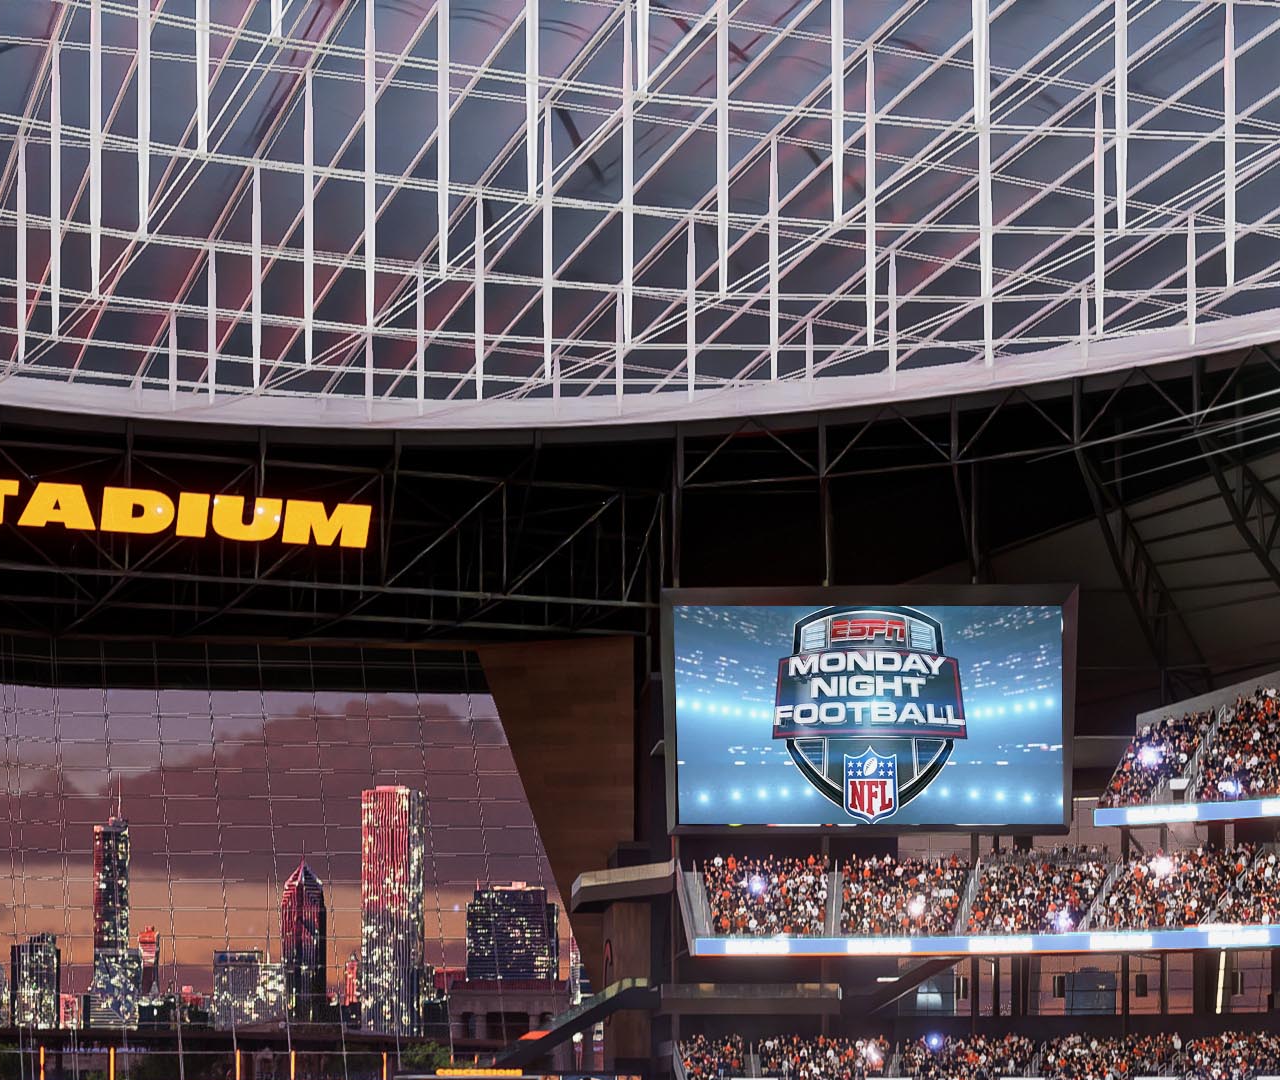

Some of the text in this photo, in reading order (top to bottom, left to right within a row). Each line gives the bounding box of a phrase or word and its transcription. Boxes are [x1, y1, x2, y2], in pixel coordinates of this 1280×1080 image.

[831, 619, 906, 643] ESPN
[788, 650, 947, 677] MONDAY
[810, 674, 927, 699] NIGHT
[773, 701, 966, 726] FOOTBALL
[849, 780, 893, 815] NFL
[436, 1068, 523, 1077] CONCESSIONS
